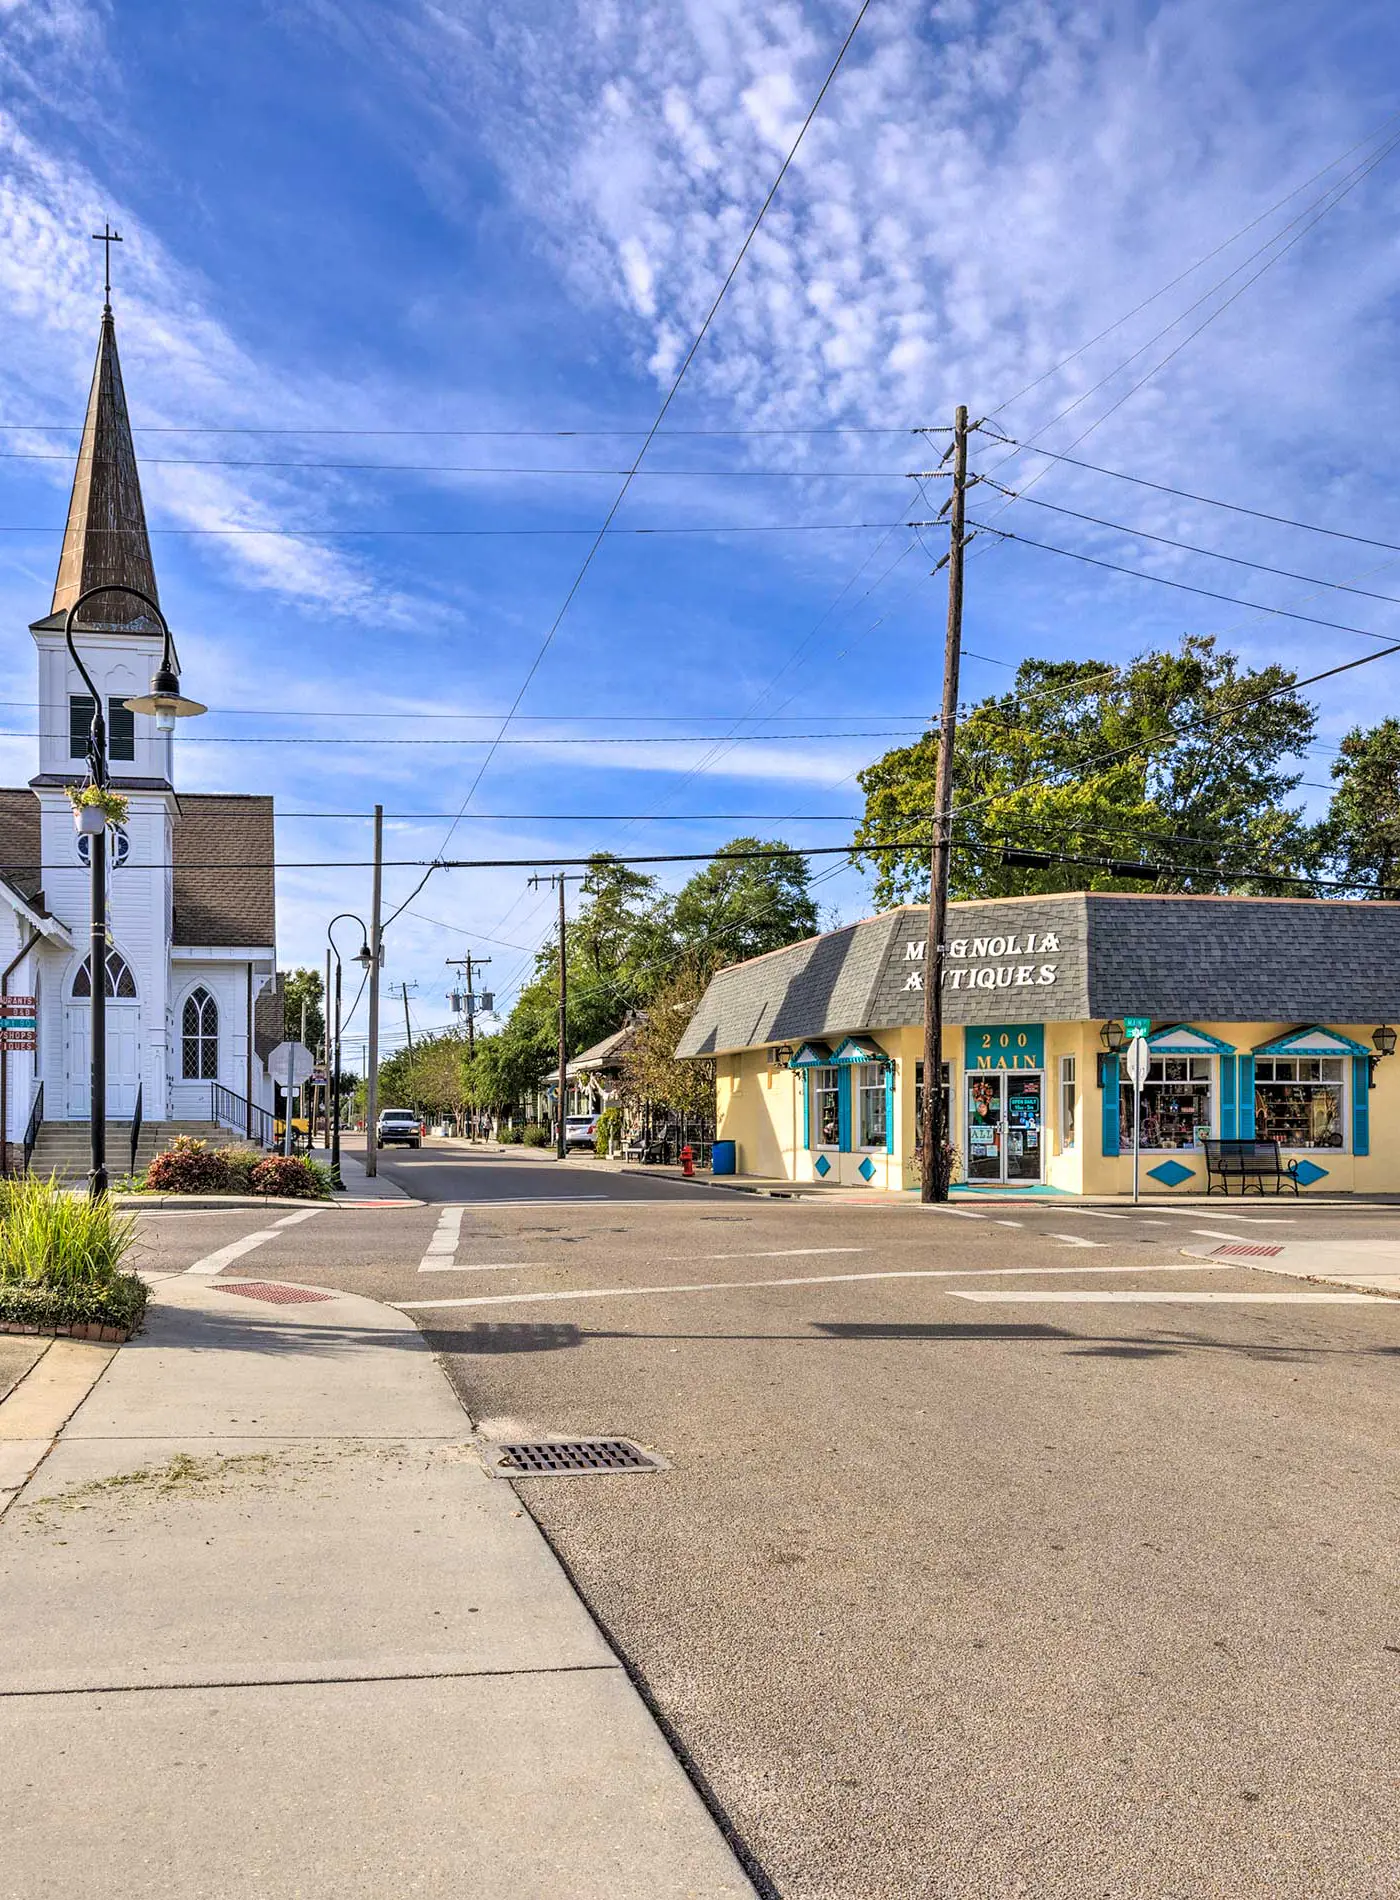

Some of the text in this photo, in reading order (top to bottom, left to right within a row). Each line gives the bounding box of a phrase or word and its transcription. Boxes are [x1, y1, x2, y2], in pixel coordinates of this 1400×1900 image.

[903, 932, 1060, 961] MGNOLIA
[981, 1032, 1027, 1048] 200
[976, 1054, 1037, 1069] MAIN
[971, 1129, 993, 1138] ALL
